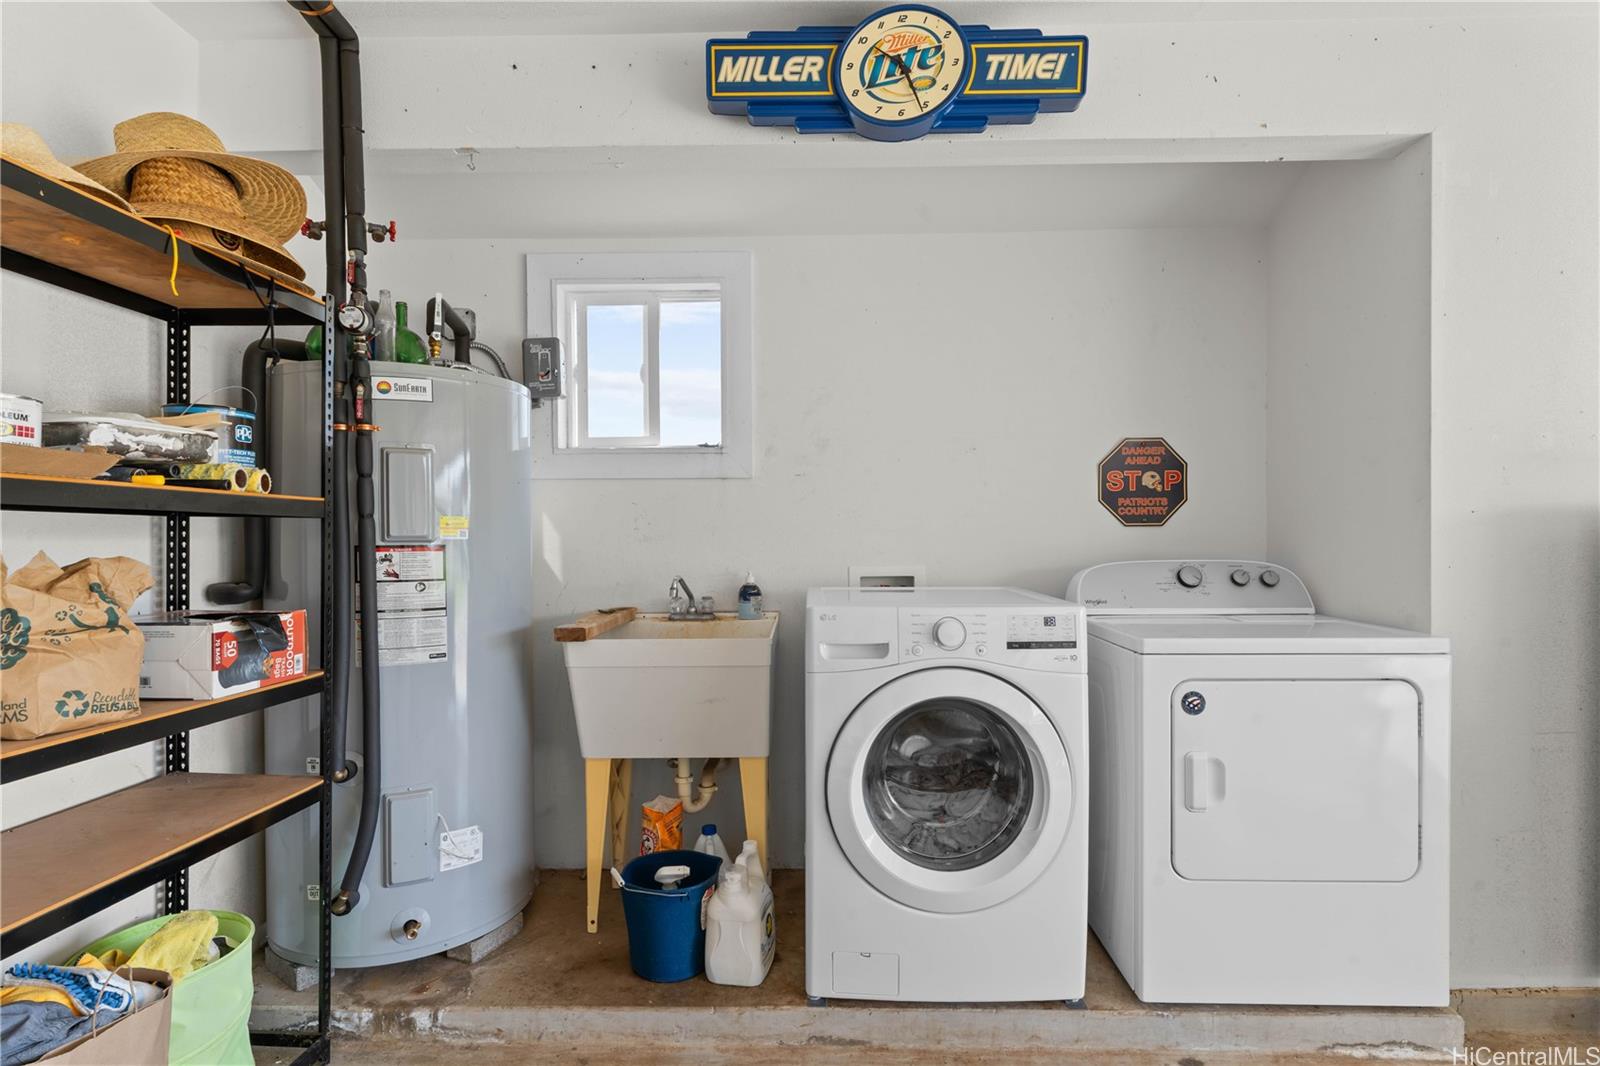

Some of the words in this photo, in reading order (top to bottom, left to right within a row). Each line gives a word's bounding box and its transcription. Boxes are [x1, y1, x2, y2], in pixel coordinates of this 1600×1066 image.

[897, 15, 908, 23] 12
[923, 16, 928, 24] 1
[877, 21, 885, 29] 11
[943, 31, 952, 39] 2
[858, 36, 868, 44] 10
[883, 33, 930, 53] Miller
[846, 62, 854, 70] 9
[952, 58, 960, 66] 3
[985, 53, 1068, 80] TIME!
[717, 55, 822, 83] MILLER
[864, 44, 944, 90] Lite
[851, 89, 859, 97] 8
[922, 101, 929, 109] 5
[0, 410, 28, 422] LEUM
[1121, 446, 1166, 455] DANGER
[1124, 456, 1161, 465] AHEAD
[1106, 470, 1182, 492] STP
[1118, 497, 1169, 506] PATRIOTS
[1118, 506, 1169, 515] COUNTRY
[227, 640, 237, 657] 50
[286, 619, 294, 677] OUTDOOR
[0, 709, 28, 724] MS
